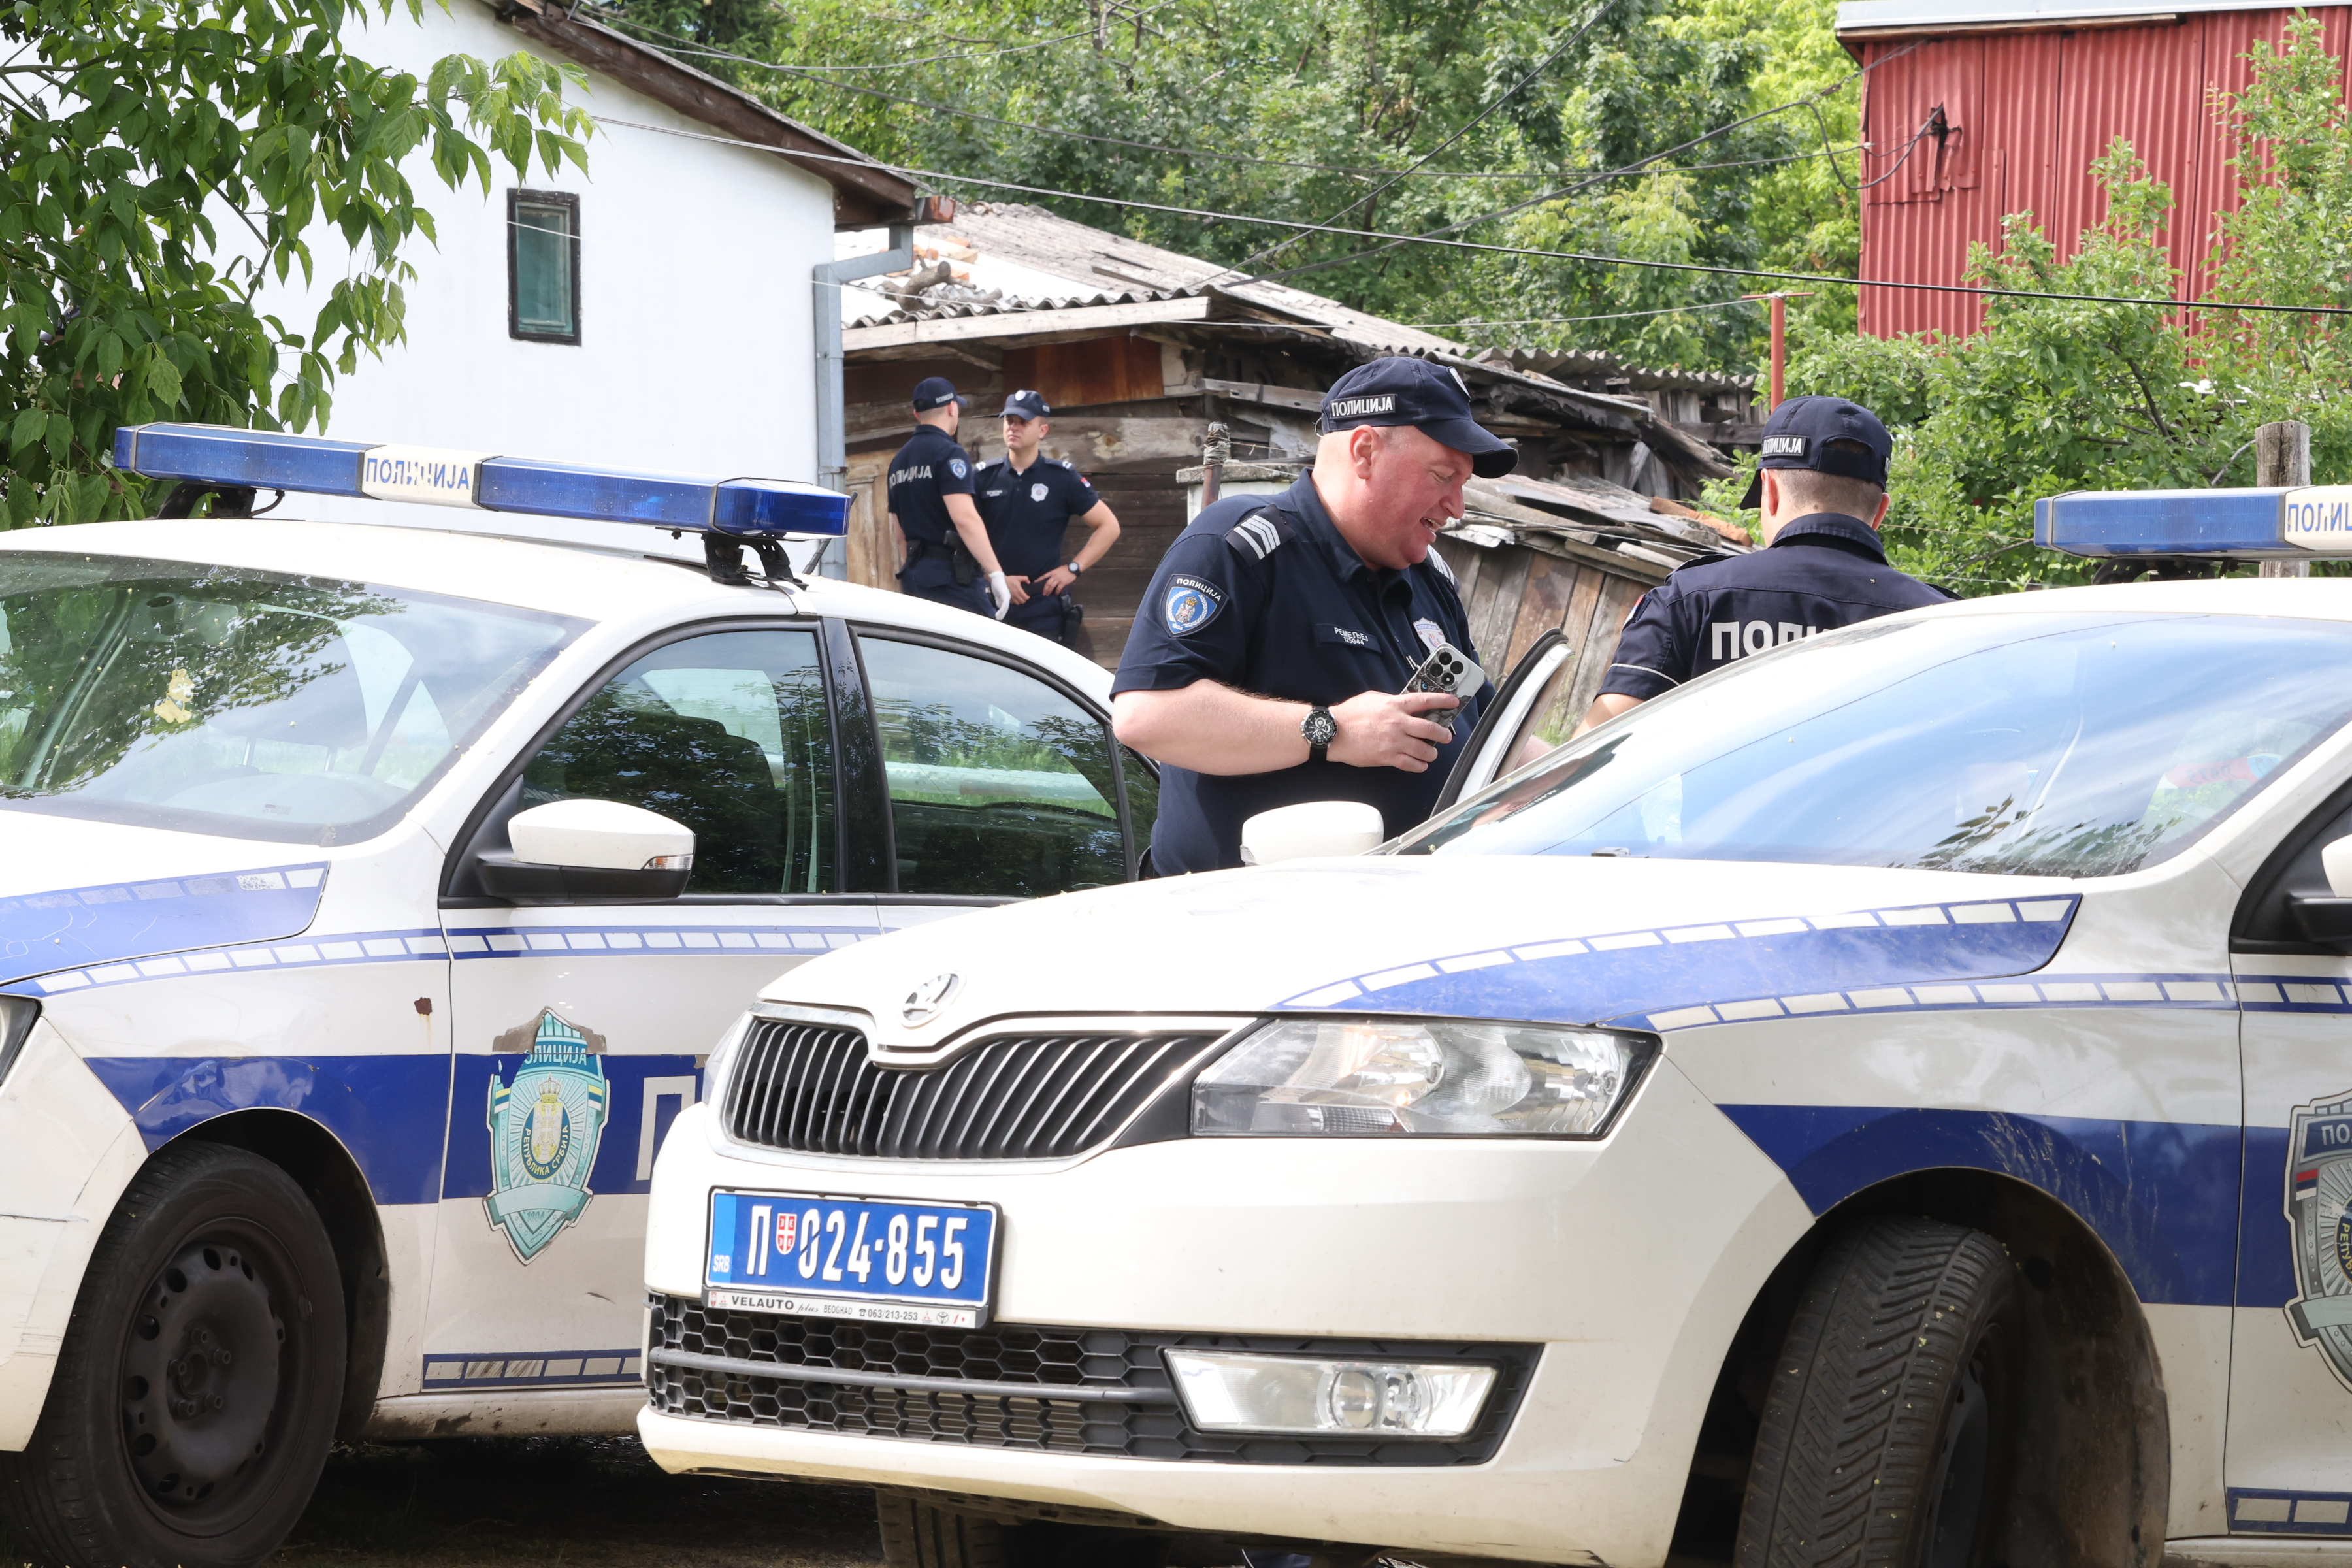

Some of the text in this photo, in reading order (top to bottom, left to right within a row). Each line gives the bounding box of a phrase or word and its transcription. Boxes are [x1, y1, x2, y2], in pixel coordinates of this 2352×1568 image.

[1331, 396, 1394, 417] ПОЛИЦИЈА
[1762, 437, 1803, 455] ПОЛИЦИЈА
[1176, 578, 1222, 602] ПОЛИЦИЈА
[523, 1124, 569, 1176] РЕПУБЛИКА СРБИЈА
[746, 1205, 772, 1276] П
[713, 1254, 731, 1273] SRB
[731, 1296, 918, 1321] VELAUTO plus BEOGRAD 063/213-253
